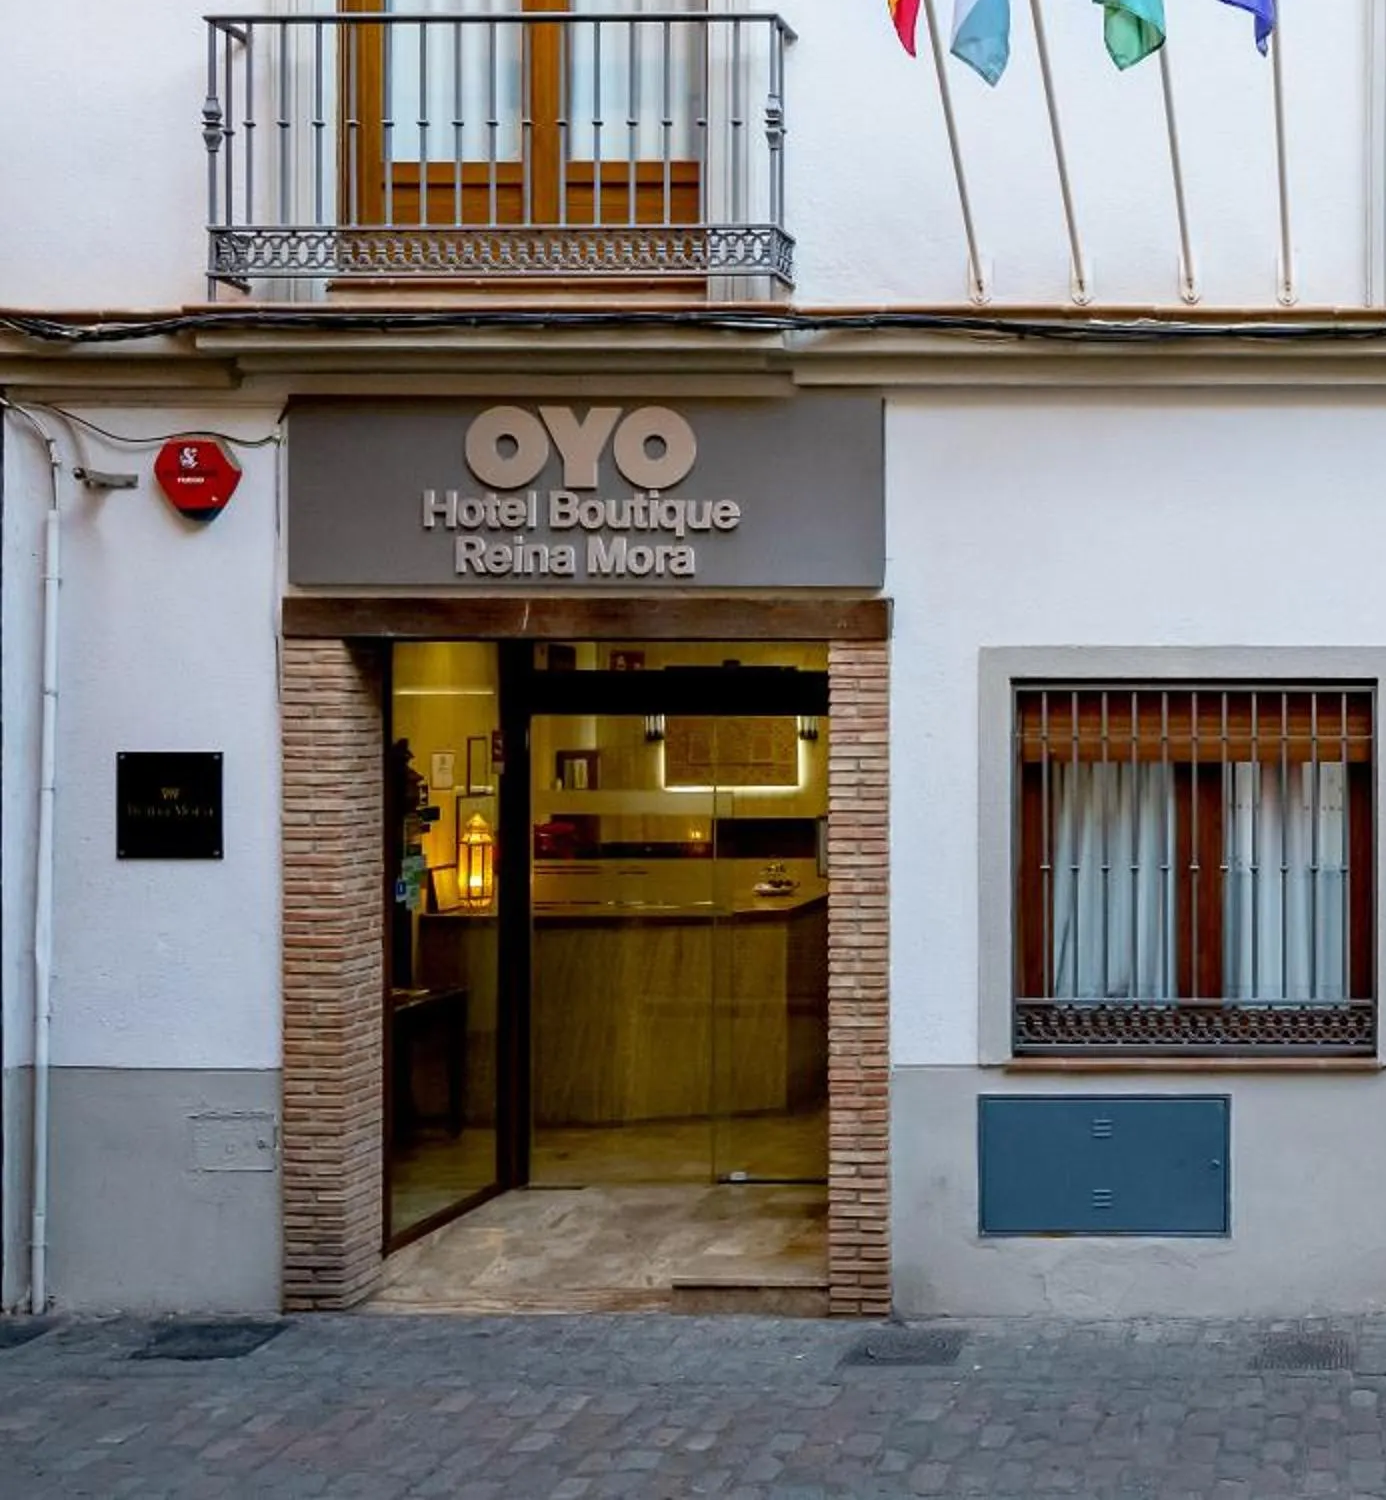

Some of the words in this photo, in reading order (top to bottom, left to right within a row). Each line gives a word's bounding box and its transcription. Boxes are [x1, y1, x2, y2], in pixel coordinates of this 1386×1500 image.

[465, 405, 697, 489] OYO
[423, 489, 537, 528] Hotel
[550, 489, 741, 537] Boutique
[455, 535, 577, 575] Reina
[587, 535, 696, 576] Mora
